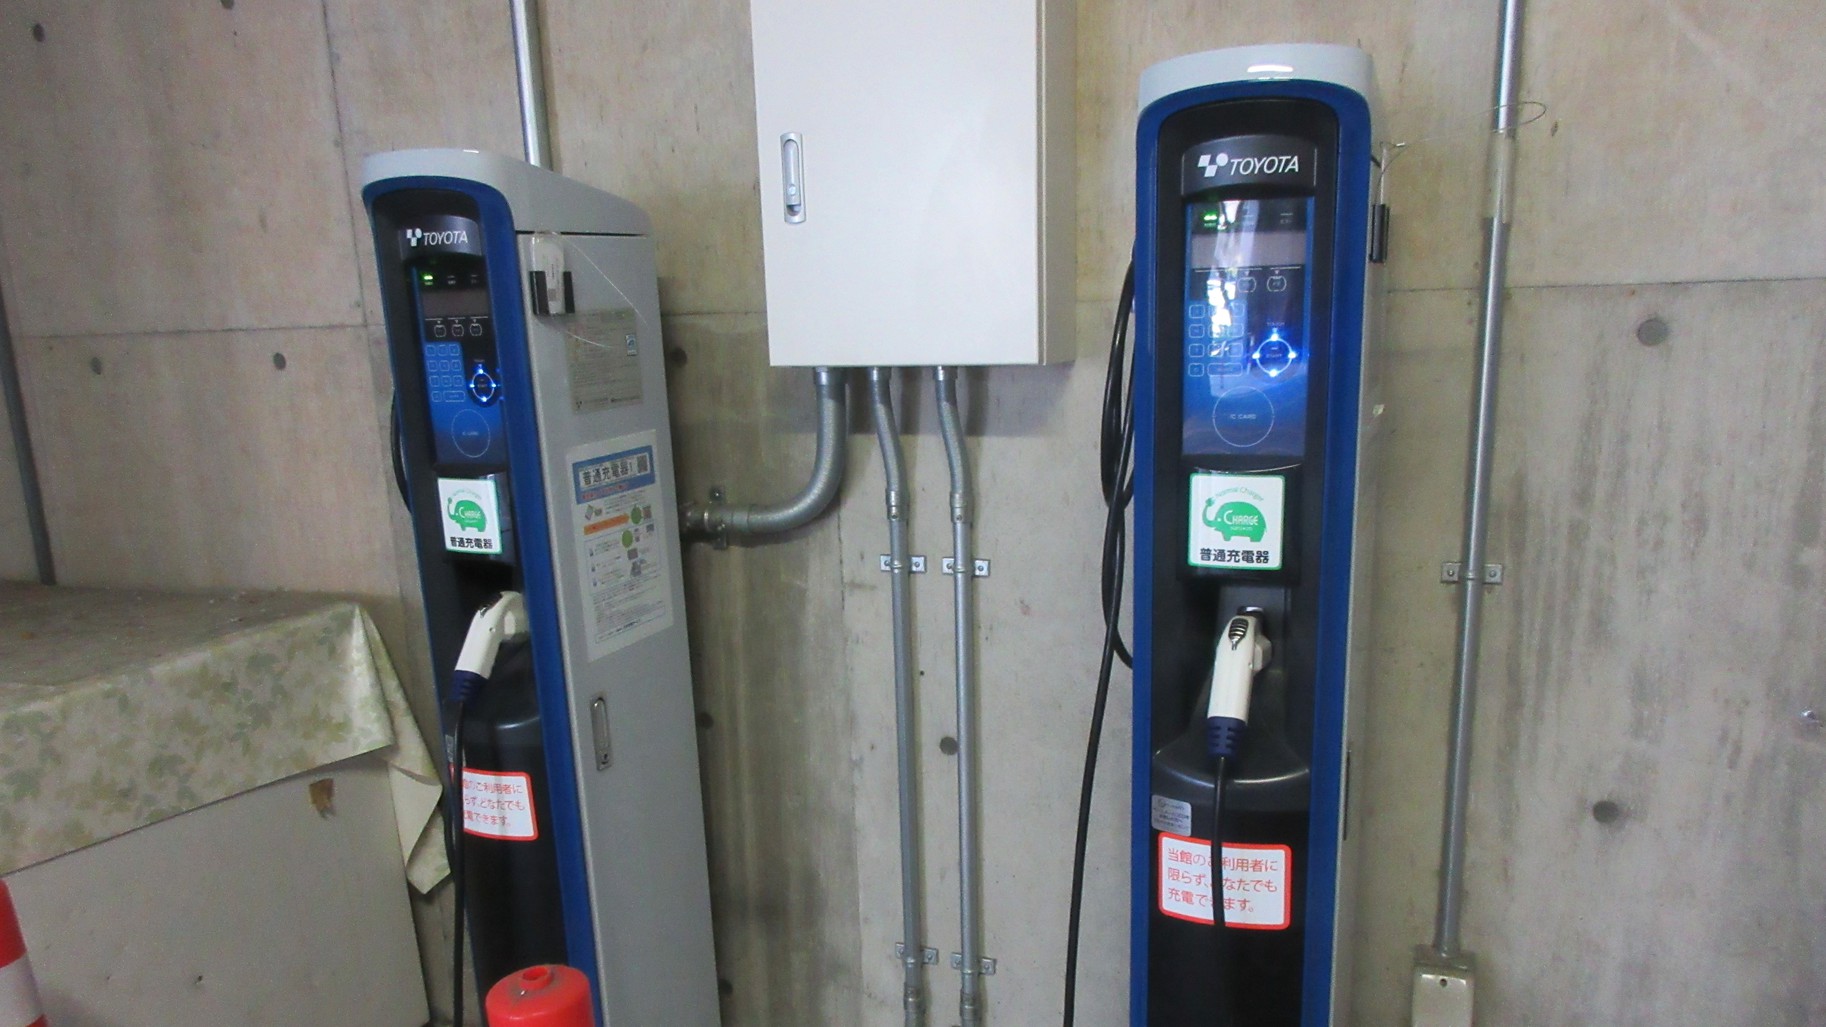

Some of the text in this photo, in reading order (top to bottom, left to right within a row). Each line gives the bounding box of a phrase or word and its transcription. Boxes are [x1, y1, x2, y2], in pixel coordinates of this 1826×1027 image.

[1230, 155, 1299, 176] TOYOTA
[423, 230, 469, 246] TOYOTA
[1223, 509, 1259, 526] CHARGE
[449, 536, 493, 549] 普通充電器
[1200, 547, 1269, 563] 普通充電器
[1168, 847, 1278, 872] 当館の利用者に
[1168, 867, 1278, 892] 限らず、なたでも
[1168, 887, 1254, 912] 充電でます。
